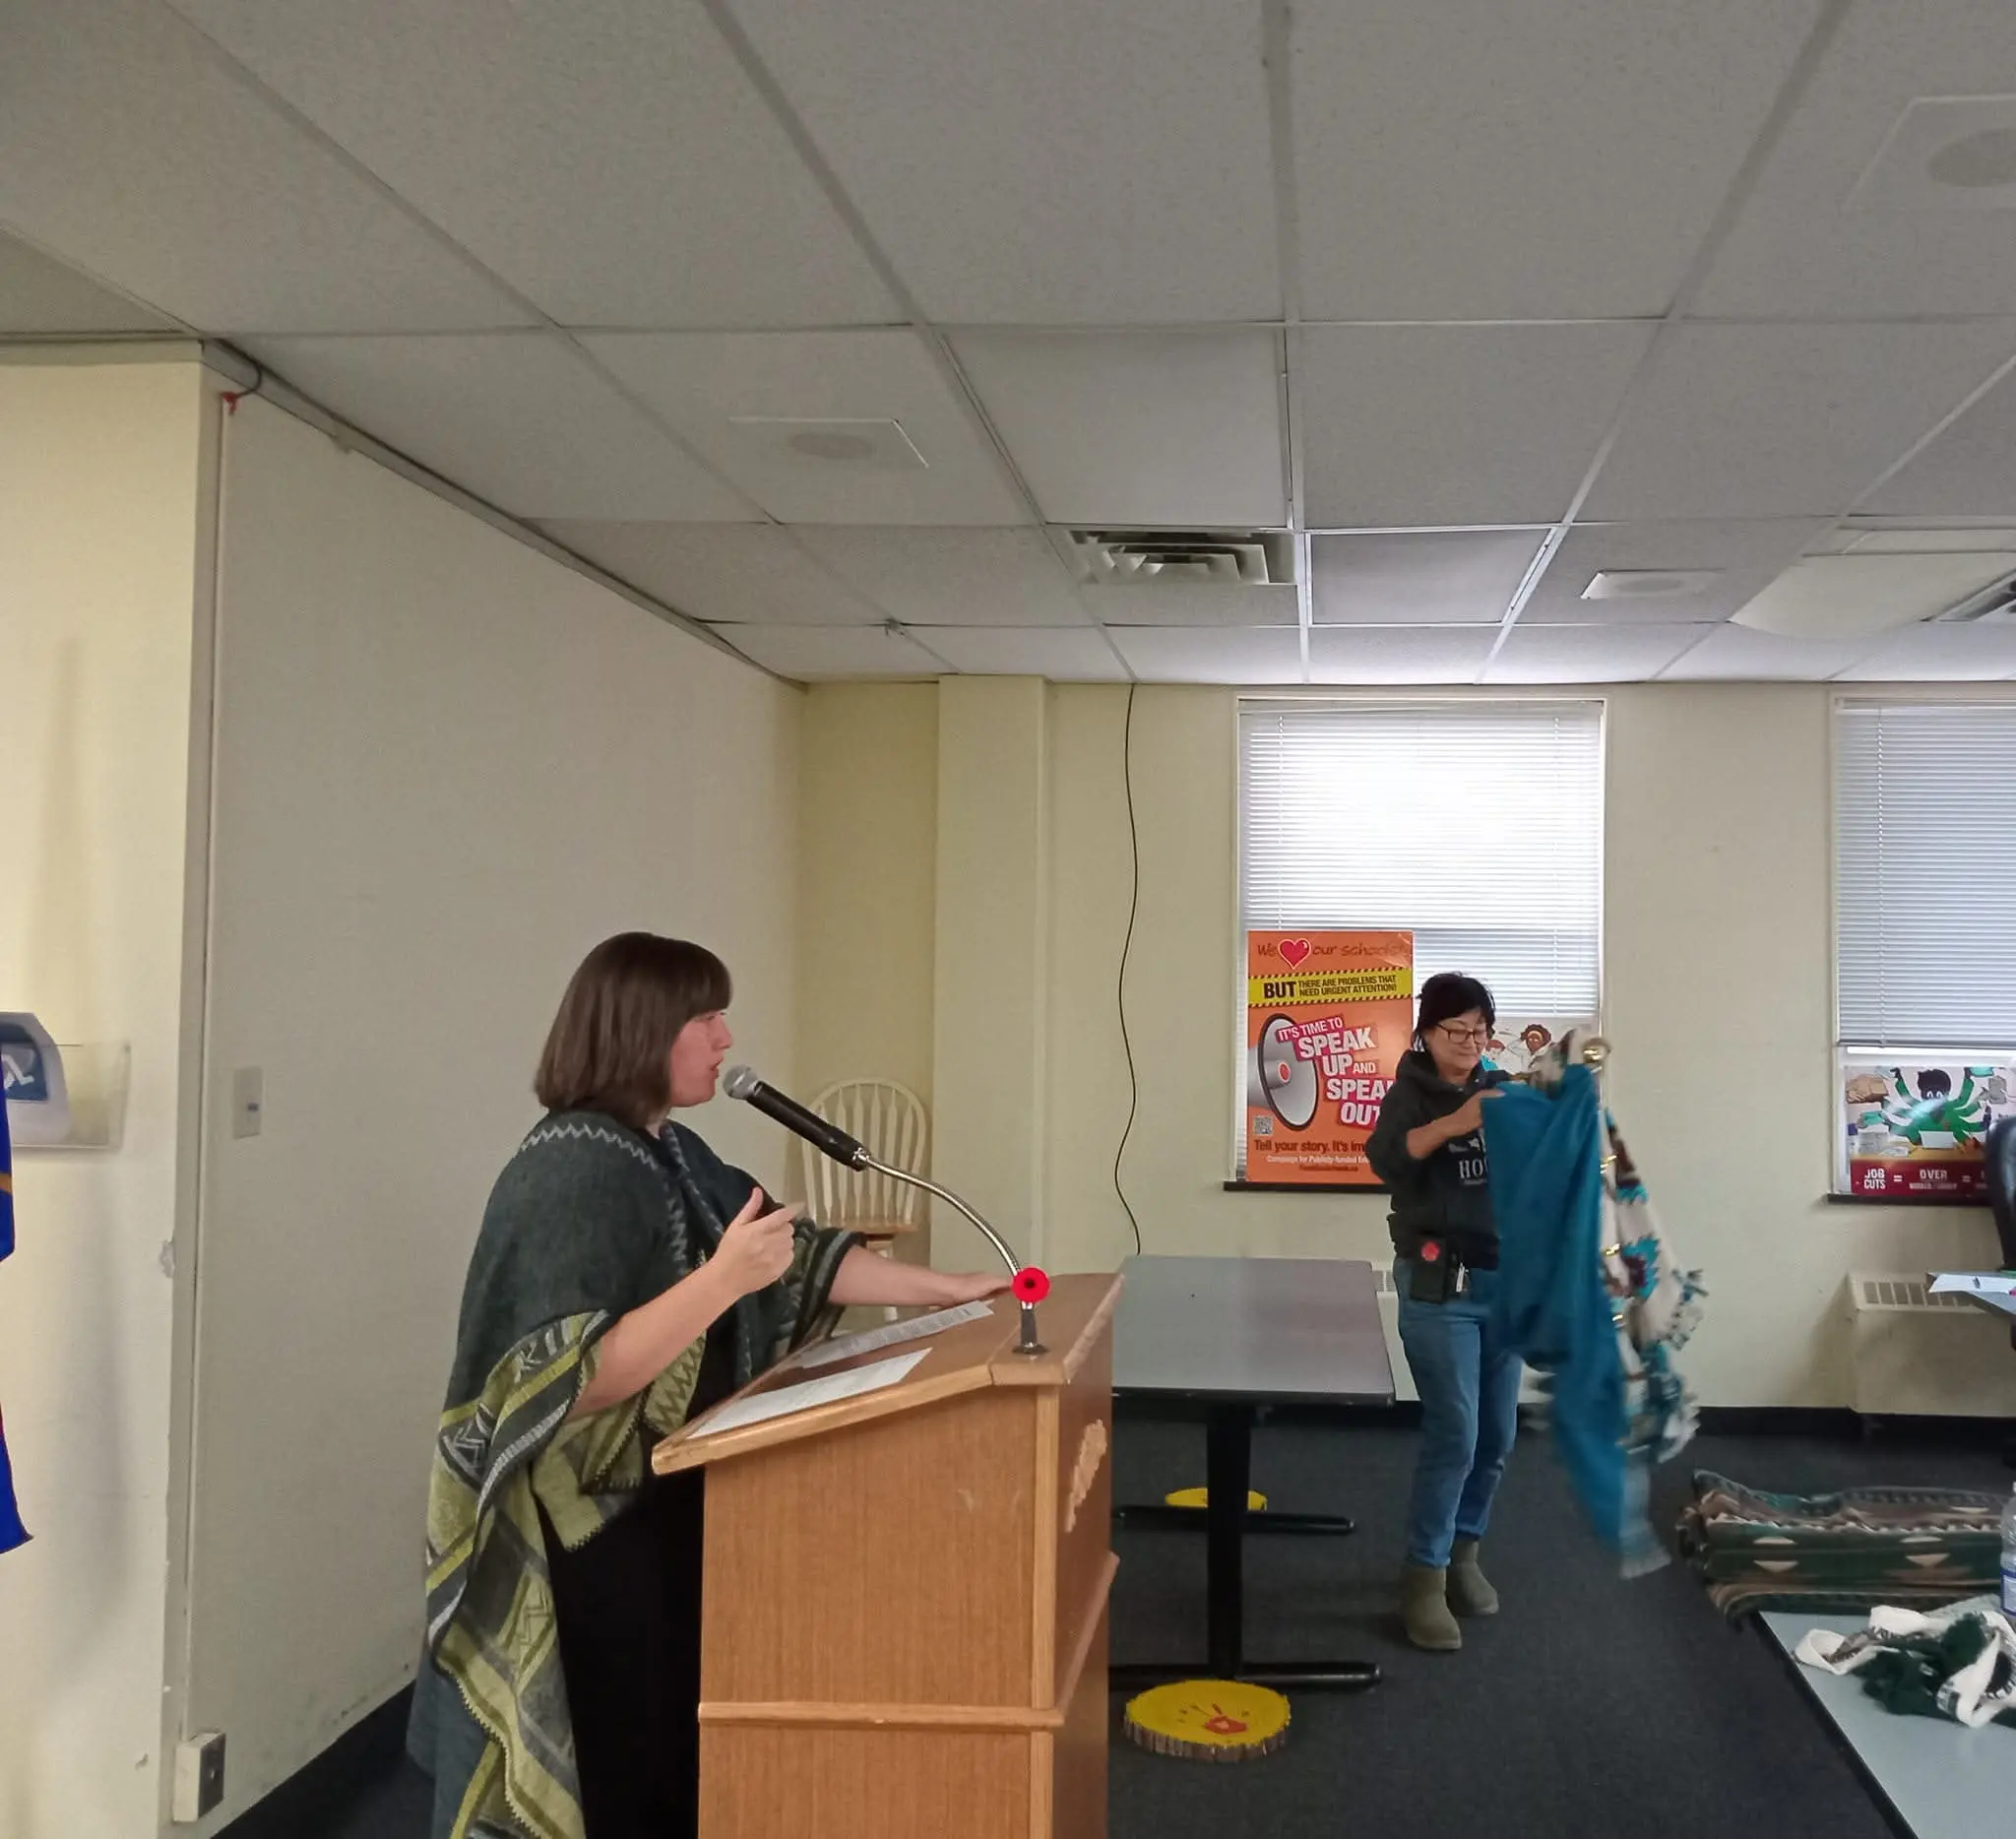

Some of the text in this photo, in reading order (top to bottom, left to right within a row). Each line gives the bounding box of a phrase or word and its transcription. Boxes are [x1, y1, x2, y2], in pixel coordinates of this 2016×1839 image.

[1258, 944, 1277, 957] We
[1312, 946, 1337, 956] our
[1299, 976, 1396, 988] THERE ARE PROBLEMS THAT
[1264, 982, 1296, 998] BUT
[1299, 987, 1320, 997] NEED
[1321, 985, 1353, 995] URGENT
[1279, 1017, 1343, 1041] IT'S TIME TO
[1298, 1027, 1376, 1058] SPEAK
[1322, 1053, 1376, 1076] UP AND
[1254, 1140, 1272, 1151] Tell
[1275, 1142, 1298, 1153] your
[1300, 1141, 1330, 1153] story.
[1332, 1141, 1349, 1151] It's
[1864, 1169, 1885, 1179] JOB
[1920, 1169, 1947, 1179] OVER
[1863, 1179, 1886, 1189] CUTS
